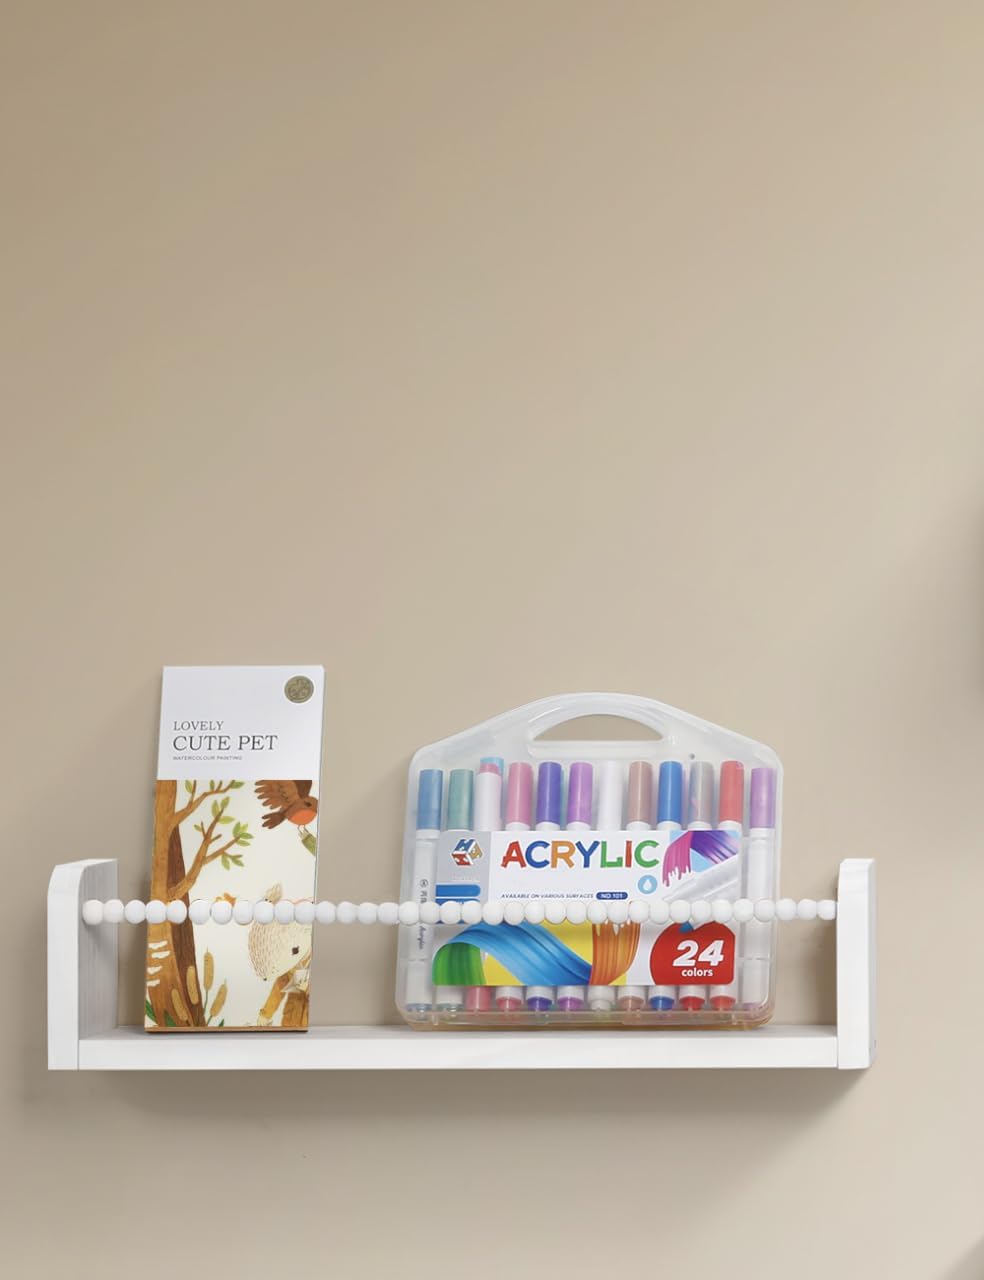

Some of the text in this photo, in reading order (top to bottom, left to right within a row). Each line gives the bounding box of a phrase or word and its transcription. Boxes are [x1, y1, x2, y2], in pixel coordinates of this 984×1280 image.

[173, 720, 224, 732] LOVELY
[172, 734, 278, 752] CUTE PET
[500, 839, 660, 870] ACRYLIC
[530, 891, 540, 899] ON
[672, 938, 725, 968] 24
[681, 967, 714, 979] colors
